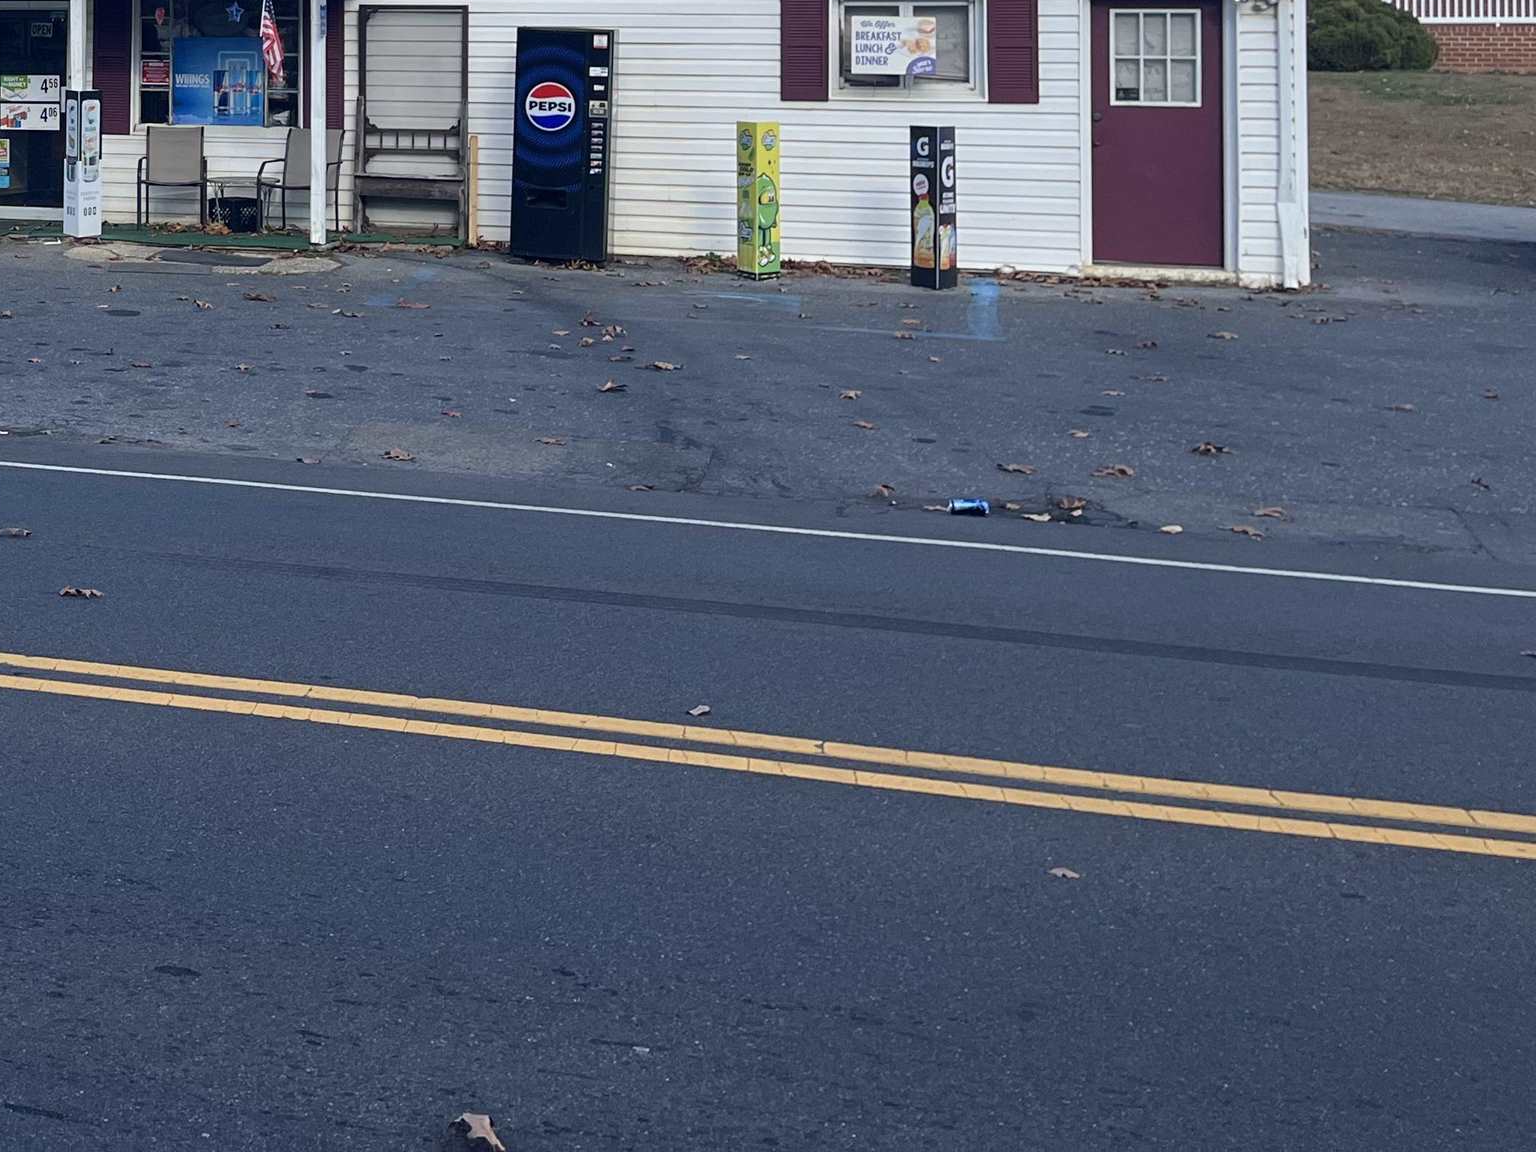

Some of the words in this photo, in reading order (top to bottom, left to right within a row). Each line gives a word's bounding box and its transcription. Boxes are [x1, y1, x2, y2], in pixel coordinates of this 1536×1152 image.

[855, 31, 902, 41] BREAKFAST
[855, 43, 883, 53] LUNCH
[885, 42, 897, 55] &
[855, 56, 888, 65] DINNER
[528, 101, 572, 113] PEPSI
